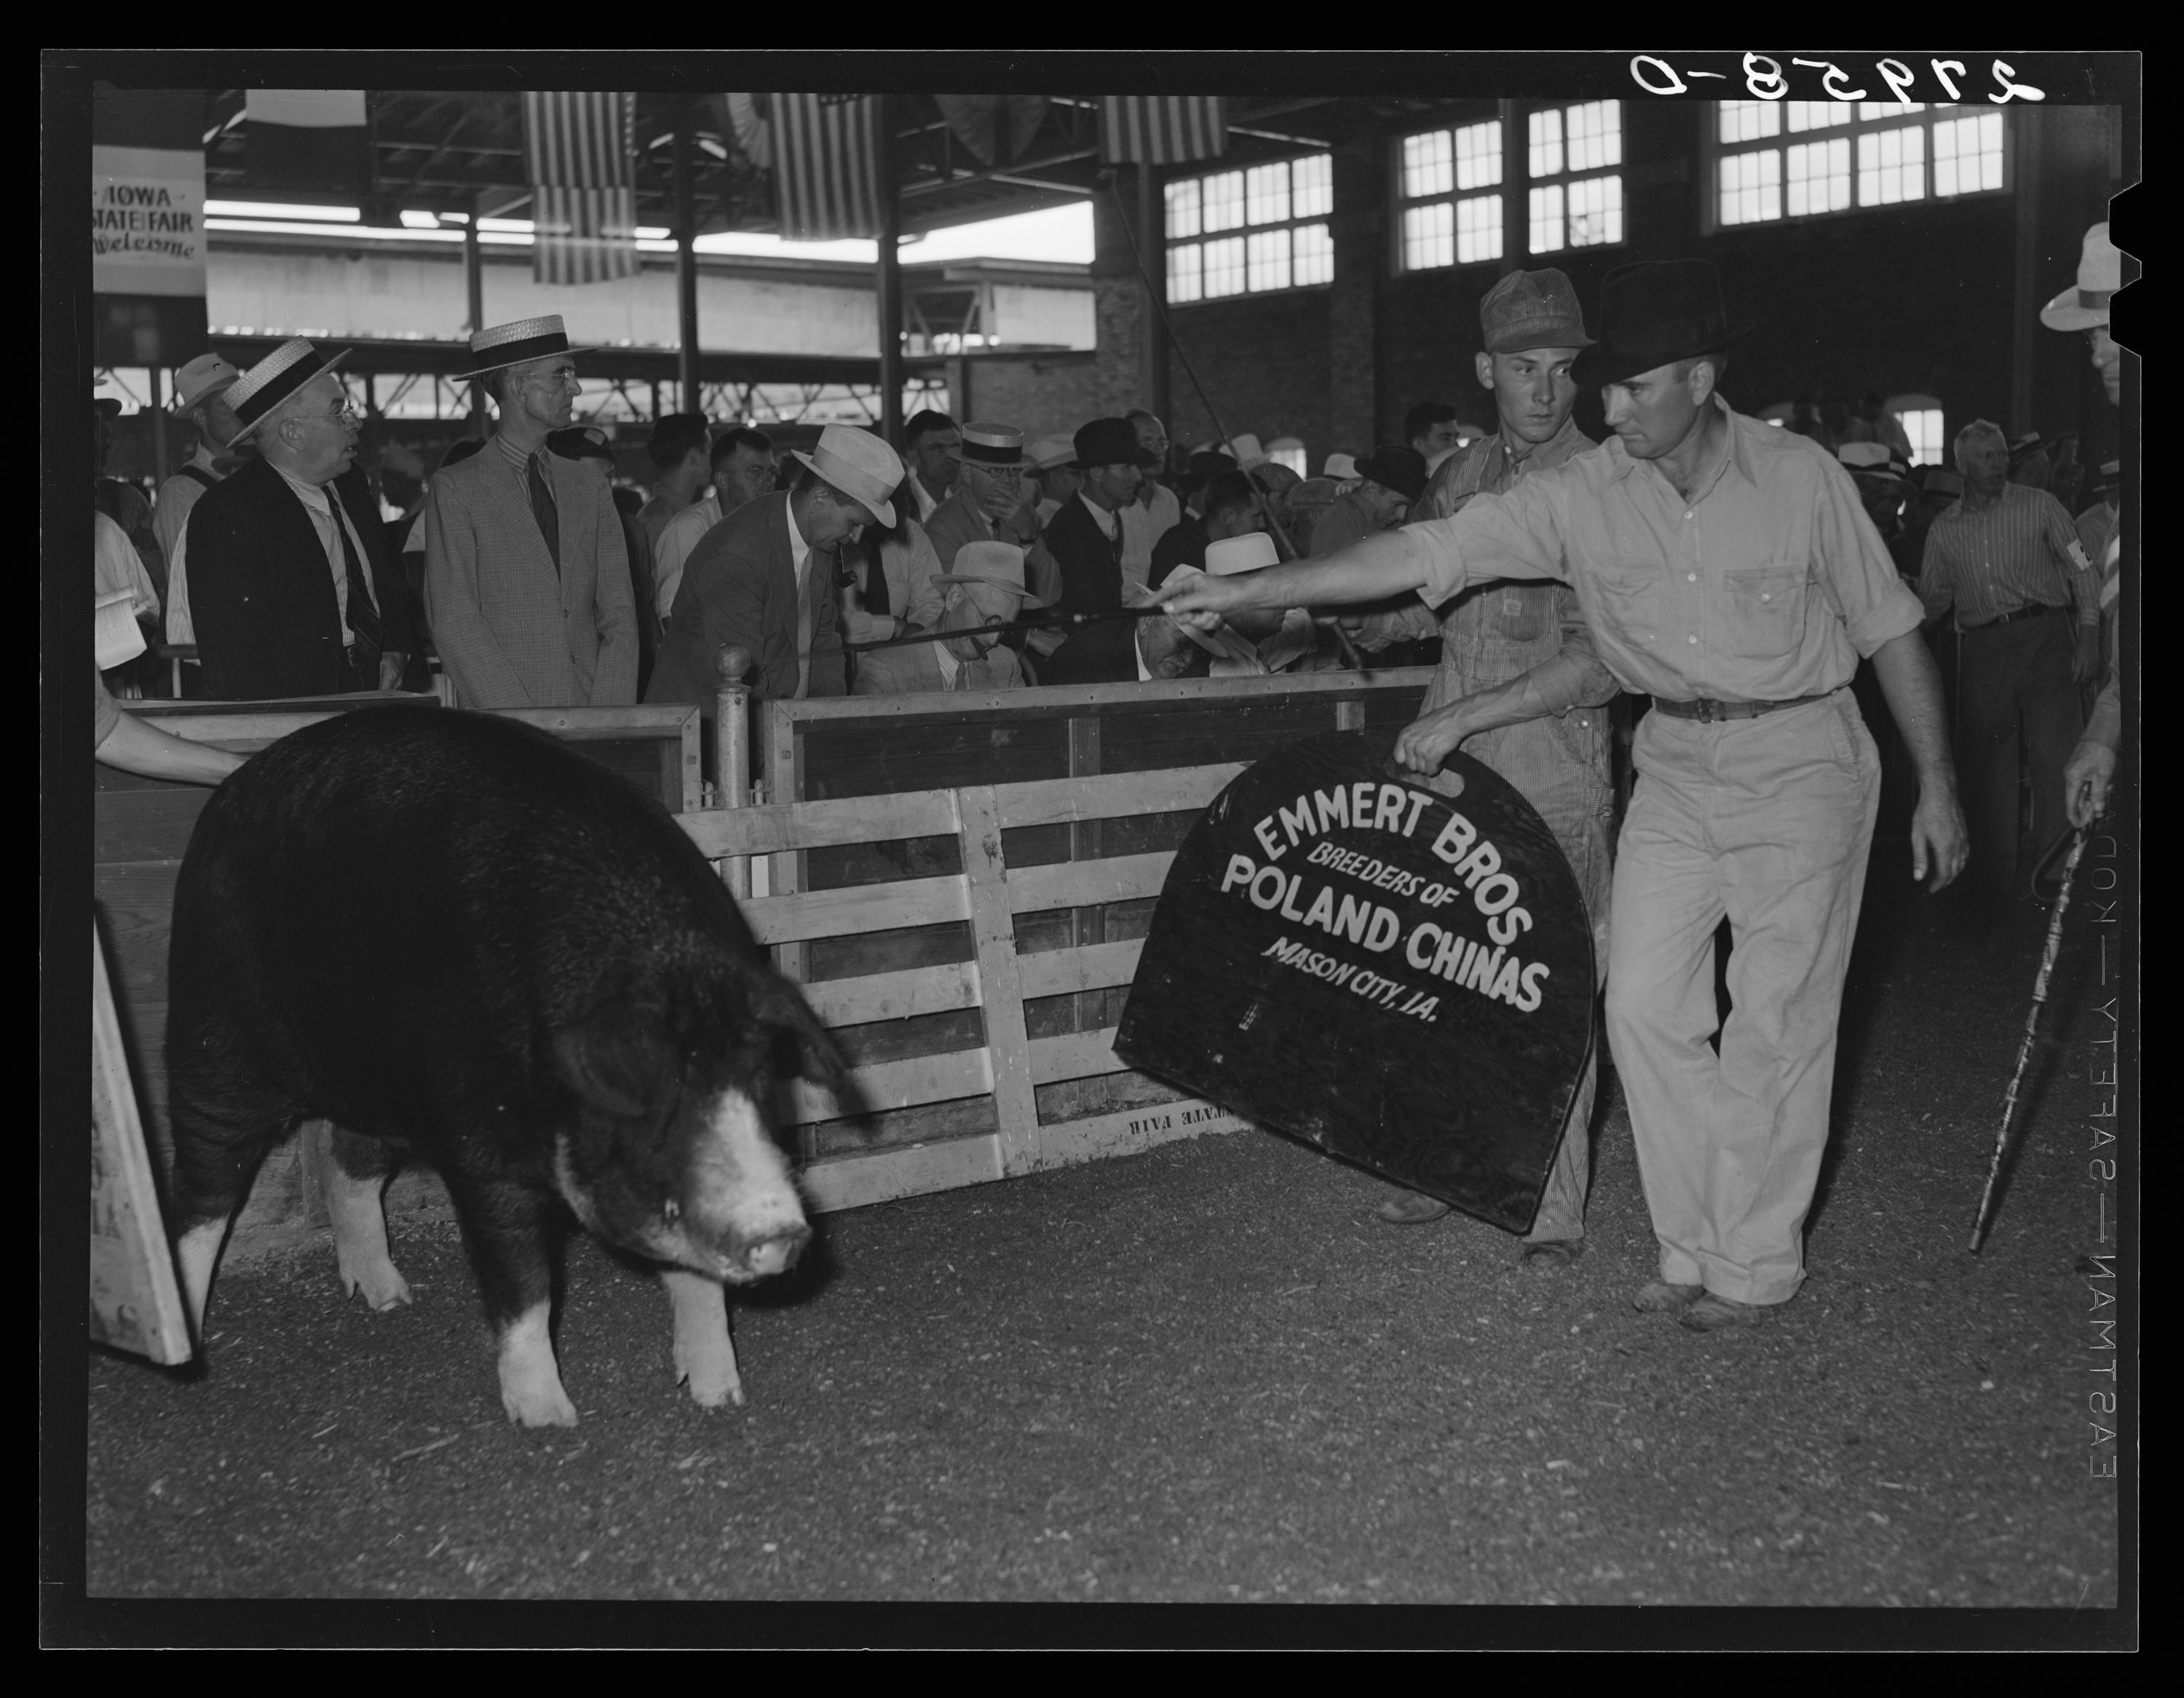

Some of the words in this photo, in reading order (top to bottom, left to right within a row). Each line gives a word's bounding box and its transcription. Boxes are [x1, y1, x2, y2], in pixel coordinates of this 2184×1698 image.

[108, 186, 172, 207] IOWA
[149, 212, 194, 233] FAIR
[93, 233, 197, 261] Welcome
[1254, 782, 1434, 861] EMMERT
[1431, 812, 1533, 945] BROS
[1307, 841, 1426, 896] BREEDERS
[1420, 883, 1460, 908] OF
[1221, 854, 1401, 952] POLAND
[1406, 922, 1550, 1012] CHINAS
[1260, 936, 1358, 986] MASON
[1350, 970, 1406, 1010] CITY,
[1398, 991, 1440, 1022] IA.
[1128, 1114, 1172, 1135] FAIR
